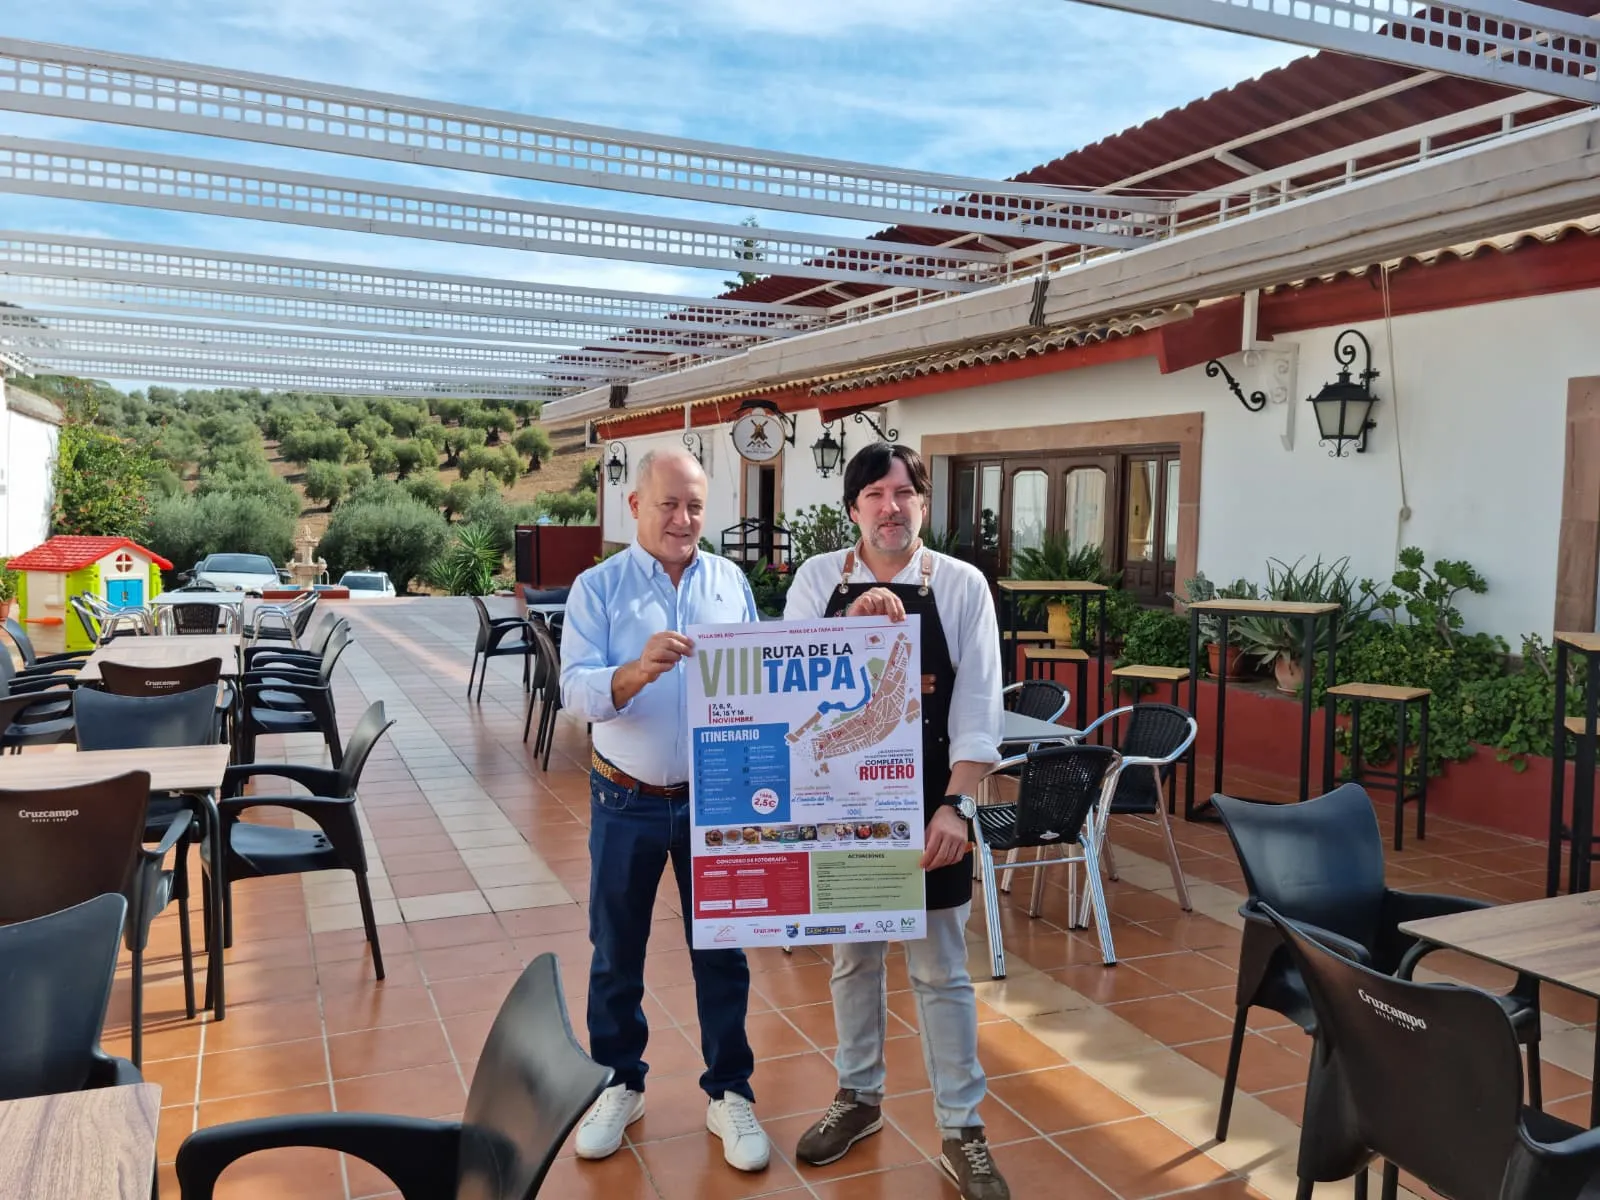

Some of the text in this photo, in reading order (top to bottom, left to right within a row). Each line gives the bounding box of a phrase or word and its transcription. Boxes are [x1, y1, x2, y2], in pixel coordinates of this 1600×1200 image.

[763, 643, 854, 659] RUTA DE LA
[698, 646, 762, 698] VIII
[763, 656, 856, 693] TAPA
[712, 716, 754, 724] NOVIEMBRE
[701, 729, 760, 743] ITINERARIO
[865, 758, 904, 766] COMPLETA
[859, 764, 915, 781] RUTERO
[18, 809, 79, 818] Cruzcampo
[1358, 989, 1427, 1029] Cruzcampo
